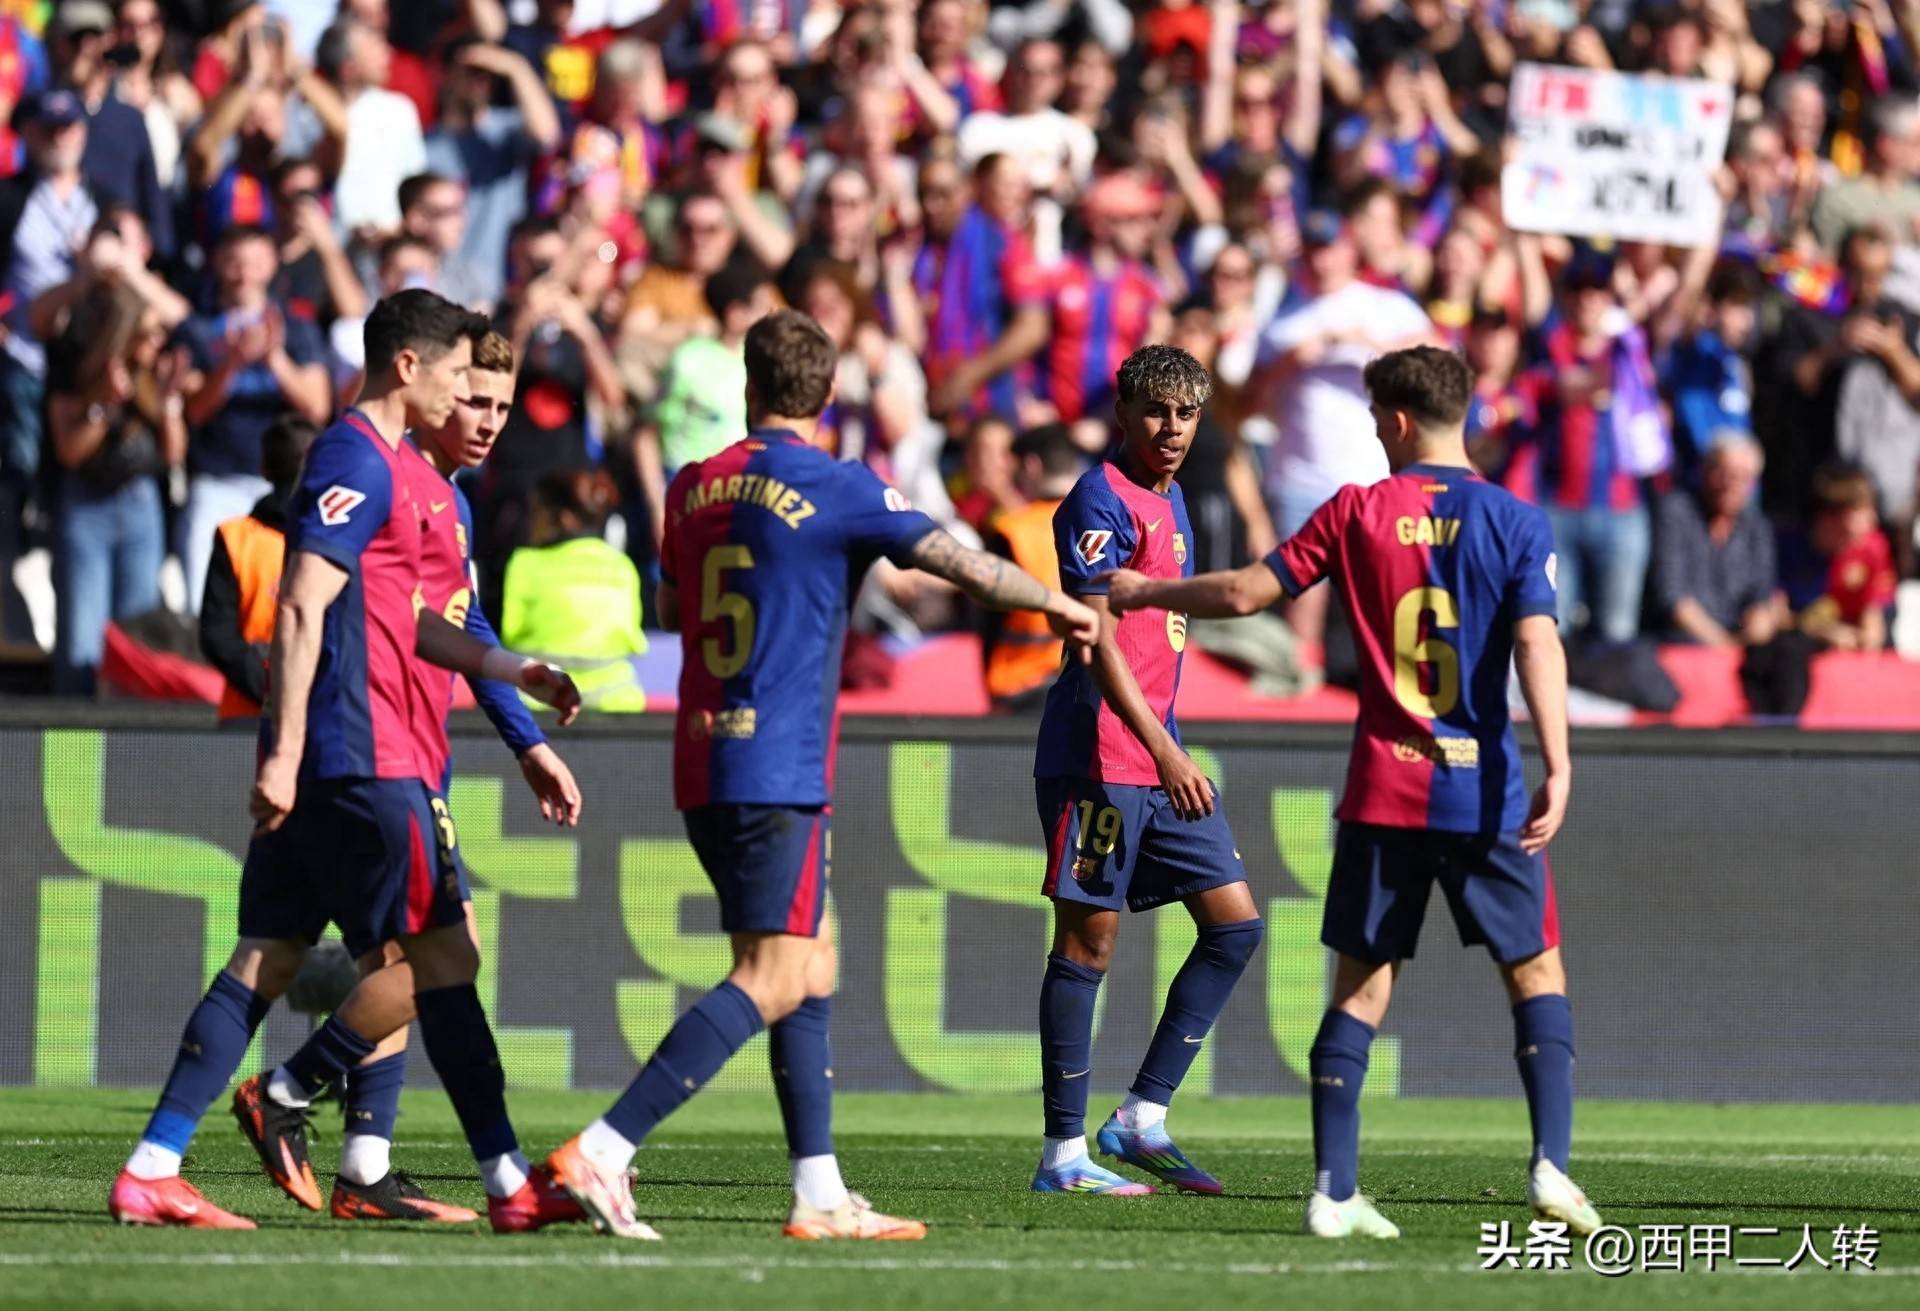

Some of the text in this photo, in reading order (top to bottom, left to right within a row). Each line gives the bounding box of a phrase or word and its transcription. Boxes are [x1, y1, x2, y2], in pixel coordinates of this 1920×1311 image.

[685, 474, 816, 529] MARTINEZ
[1395, 515, 1460, 546] GAVI
[701, 545, 755, 678] 5
[1394, 586, 1459, 718] 6
[1076, 800, 1122, 855] 19
